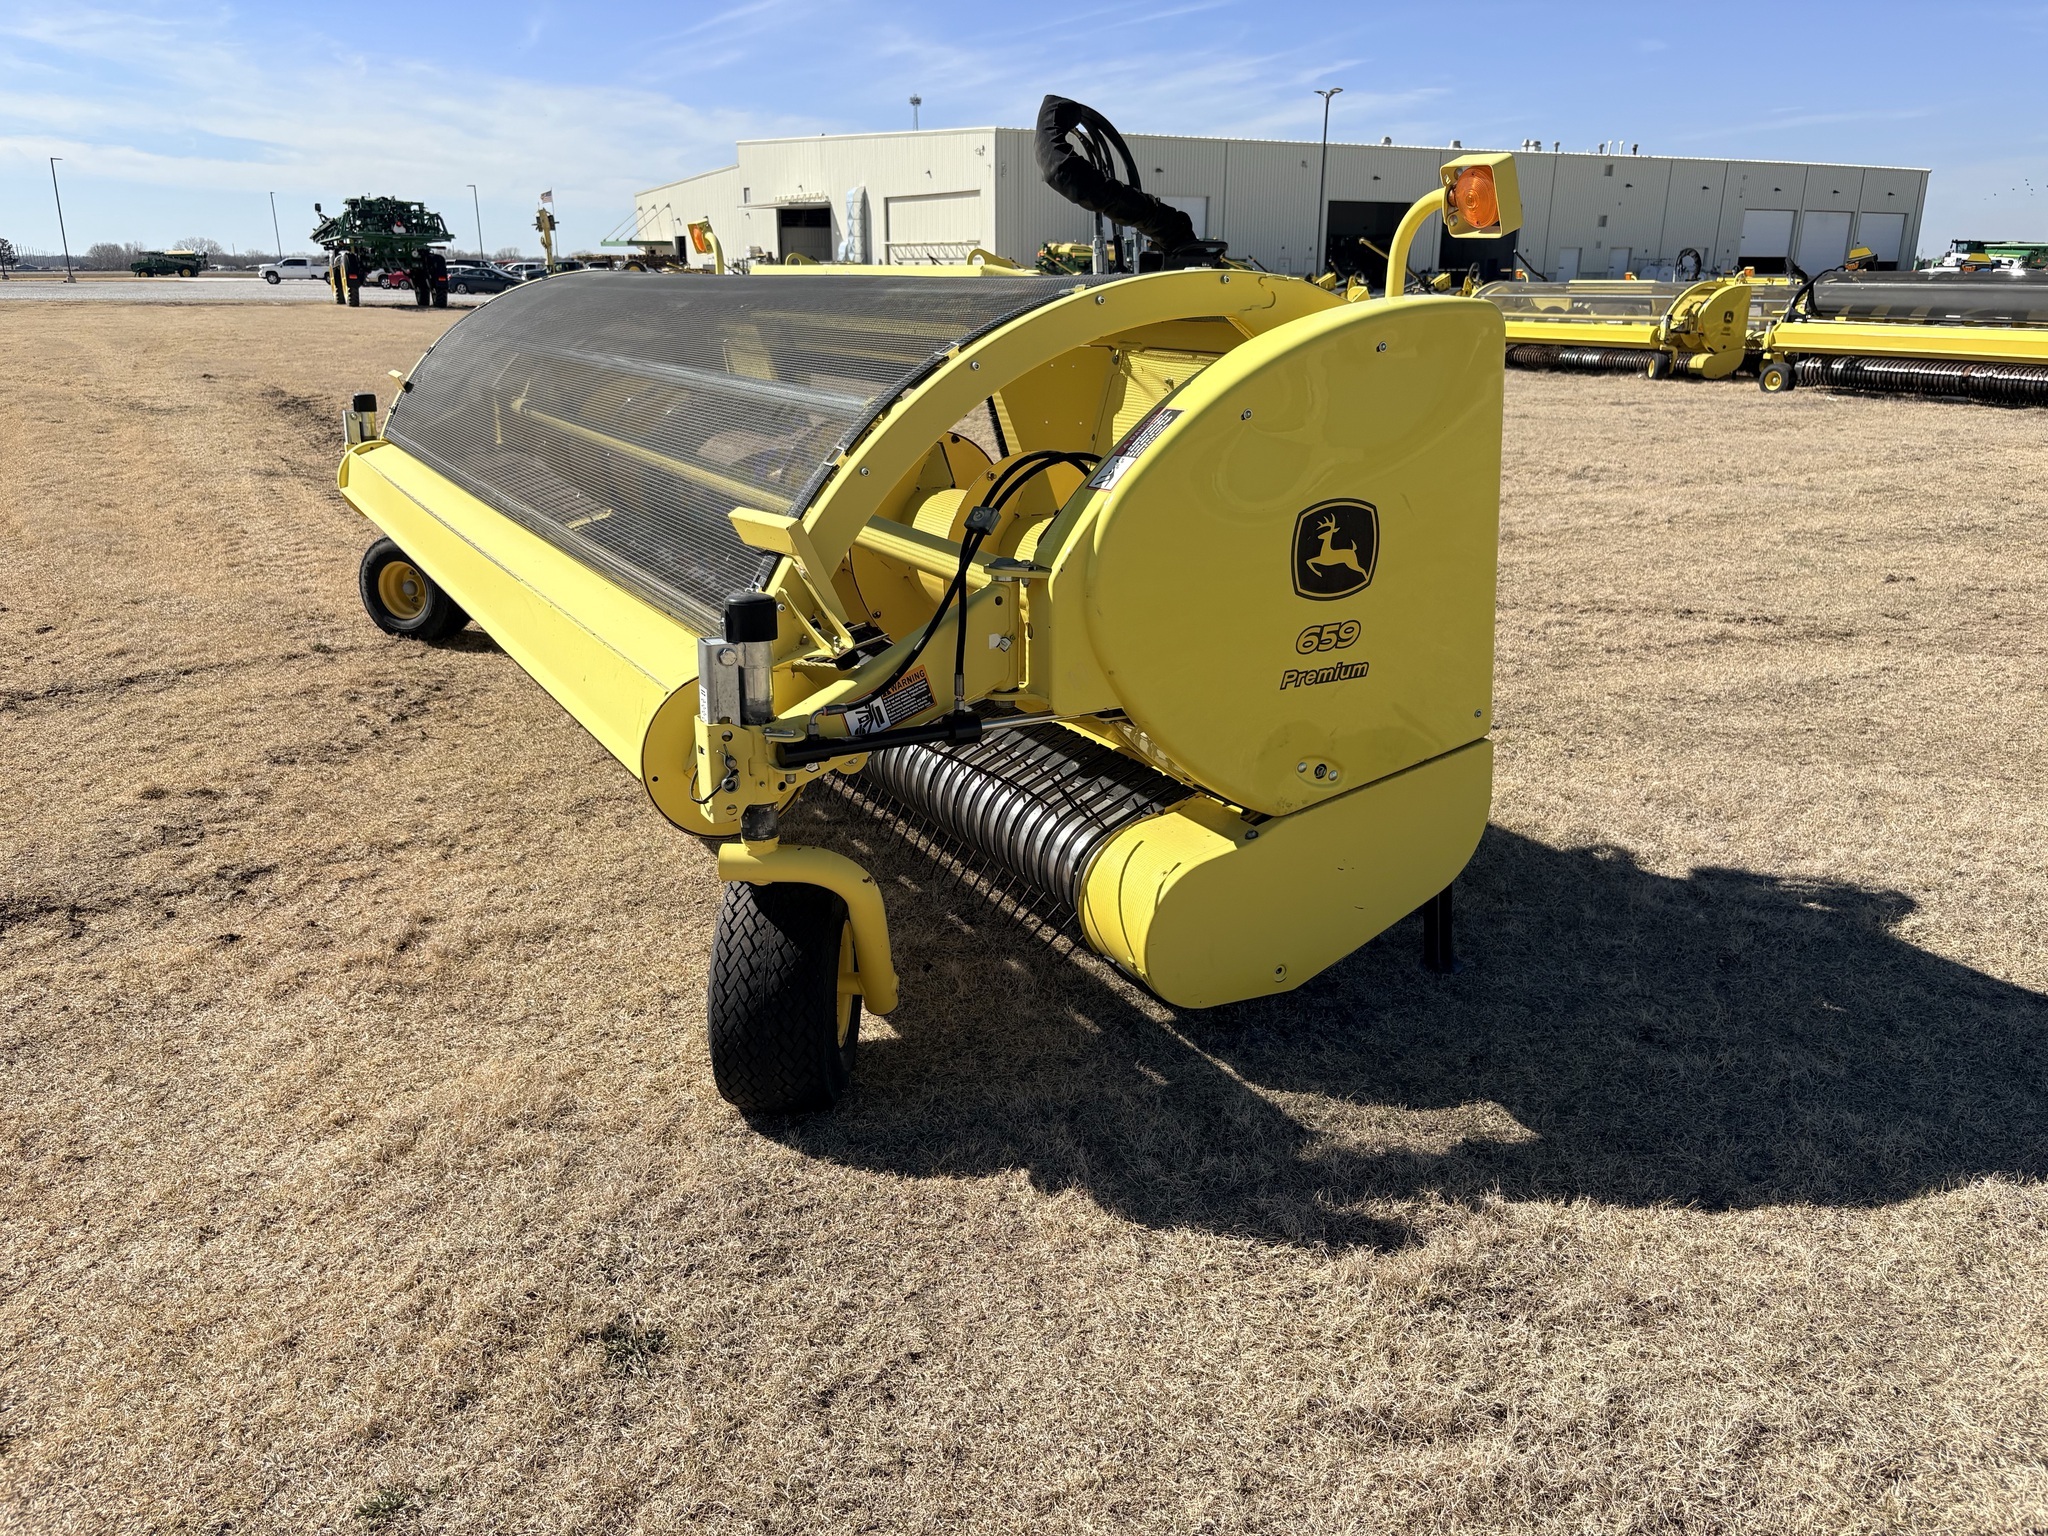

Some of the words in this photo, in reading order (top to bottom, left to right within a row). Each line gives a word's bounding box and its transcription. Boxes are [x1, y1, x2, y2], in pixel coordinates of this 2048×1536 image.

[1296, 620, 1361, 655] 659
[891, 669, 925, 692] WARNING
[1280, 662, 1369, 690] Premium
